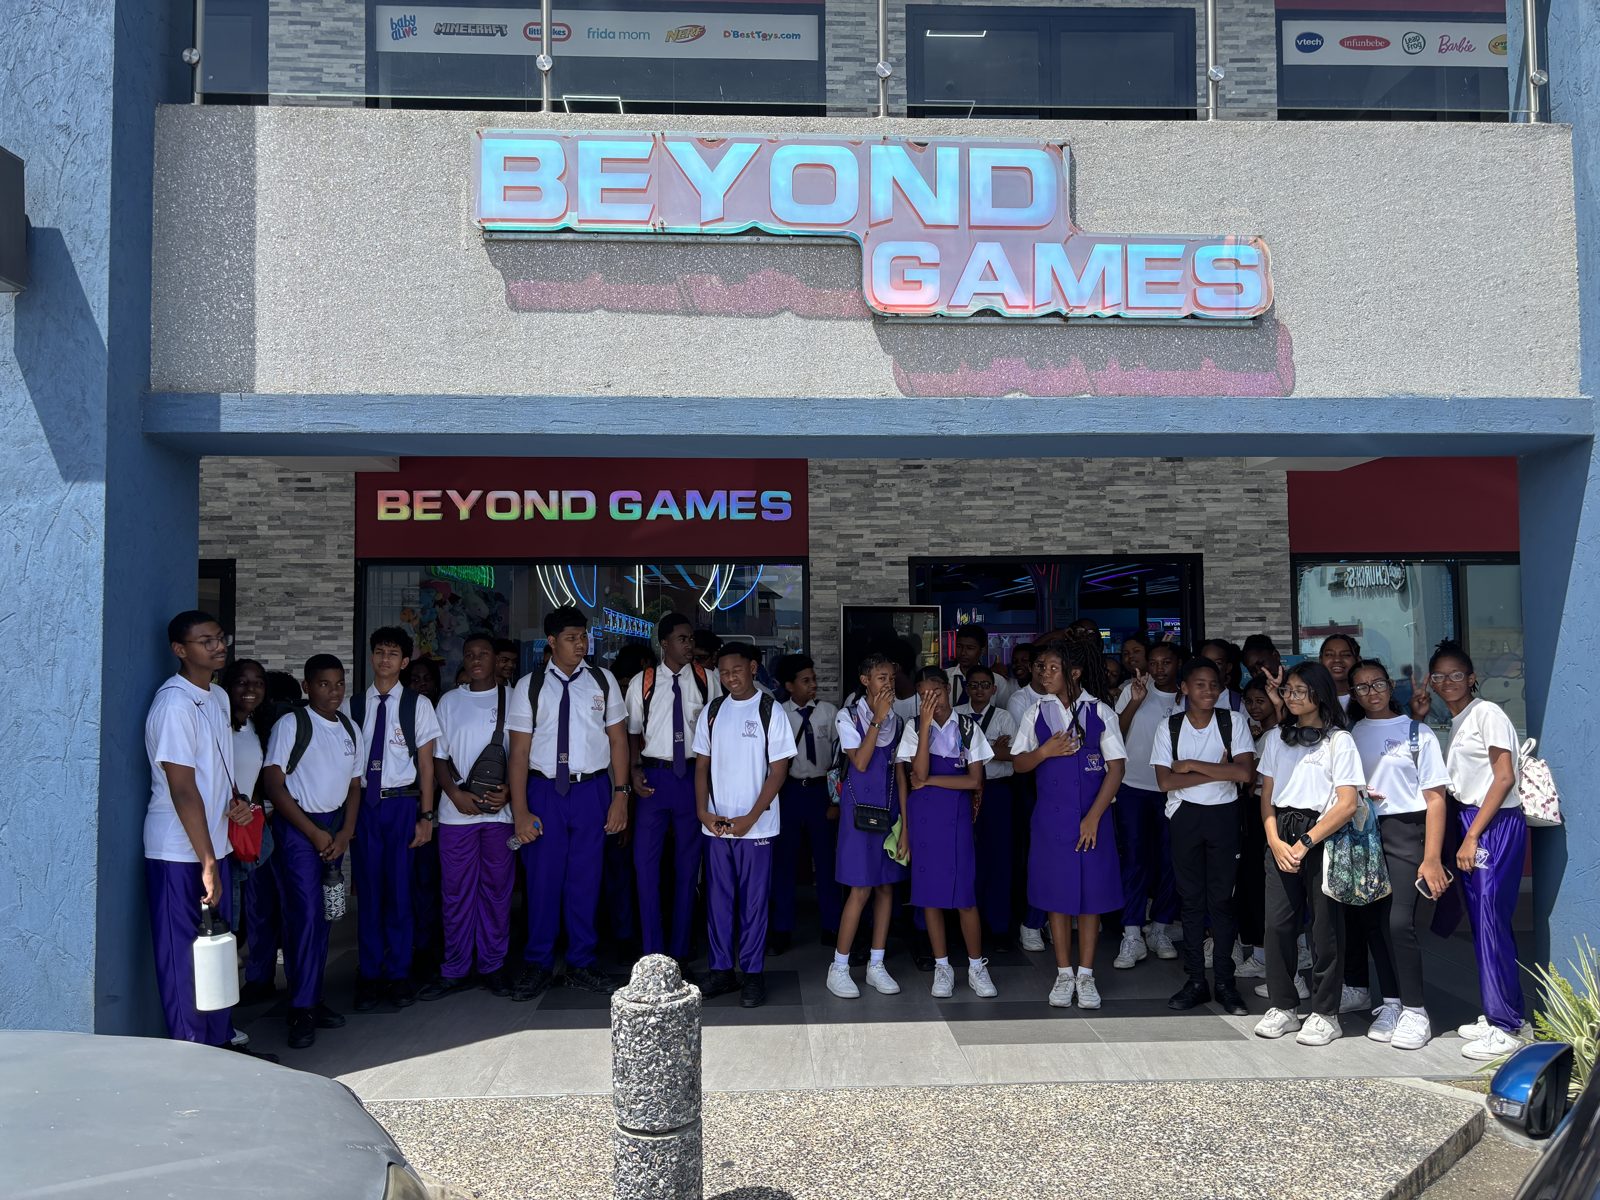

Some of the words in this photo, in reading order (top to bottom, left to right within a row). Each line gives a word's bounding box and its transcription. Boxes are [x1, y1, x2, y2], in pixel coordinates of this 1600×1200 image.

[390, 14, 416, 31] baby
[434, 22, 508, 37] MINECRAFT
[587, 27, 616, 40] frida
[619, 30, 651, 40] mom
[665, 26, 704, 43] NERF
[723, 29, 801, 41] D'BestToys.com
[1405, 35, 1421, 44] Leap
[1296, 37, 1322, 46] vtech
[1344, 38, 1385, 47] infunbebe
[1407, 41, 1423, 51] Frog
[1438, 34, 1477, 54] Barbie
[481, 135, 1057, 230] BEYOND
[869, 240, 1265, 312] GAMES
[377, 489, 597, 521] BEYOND
[609, 489, 792, 521] GAMES
